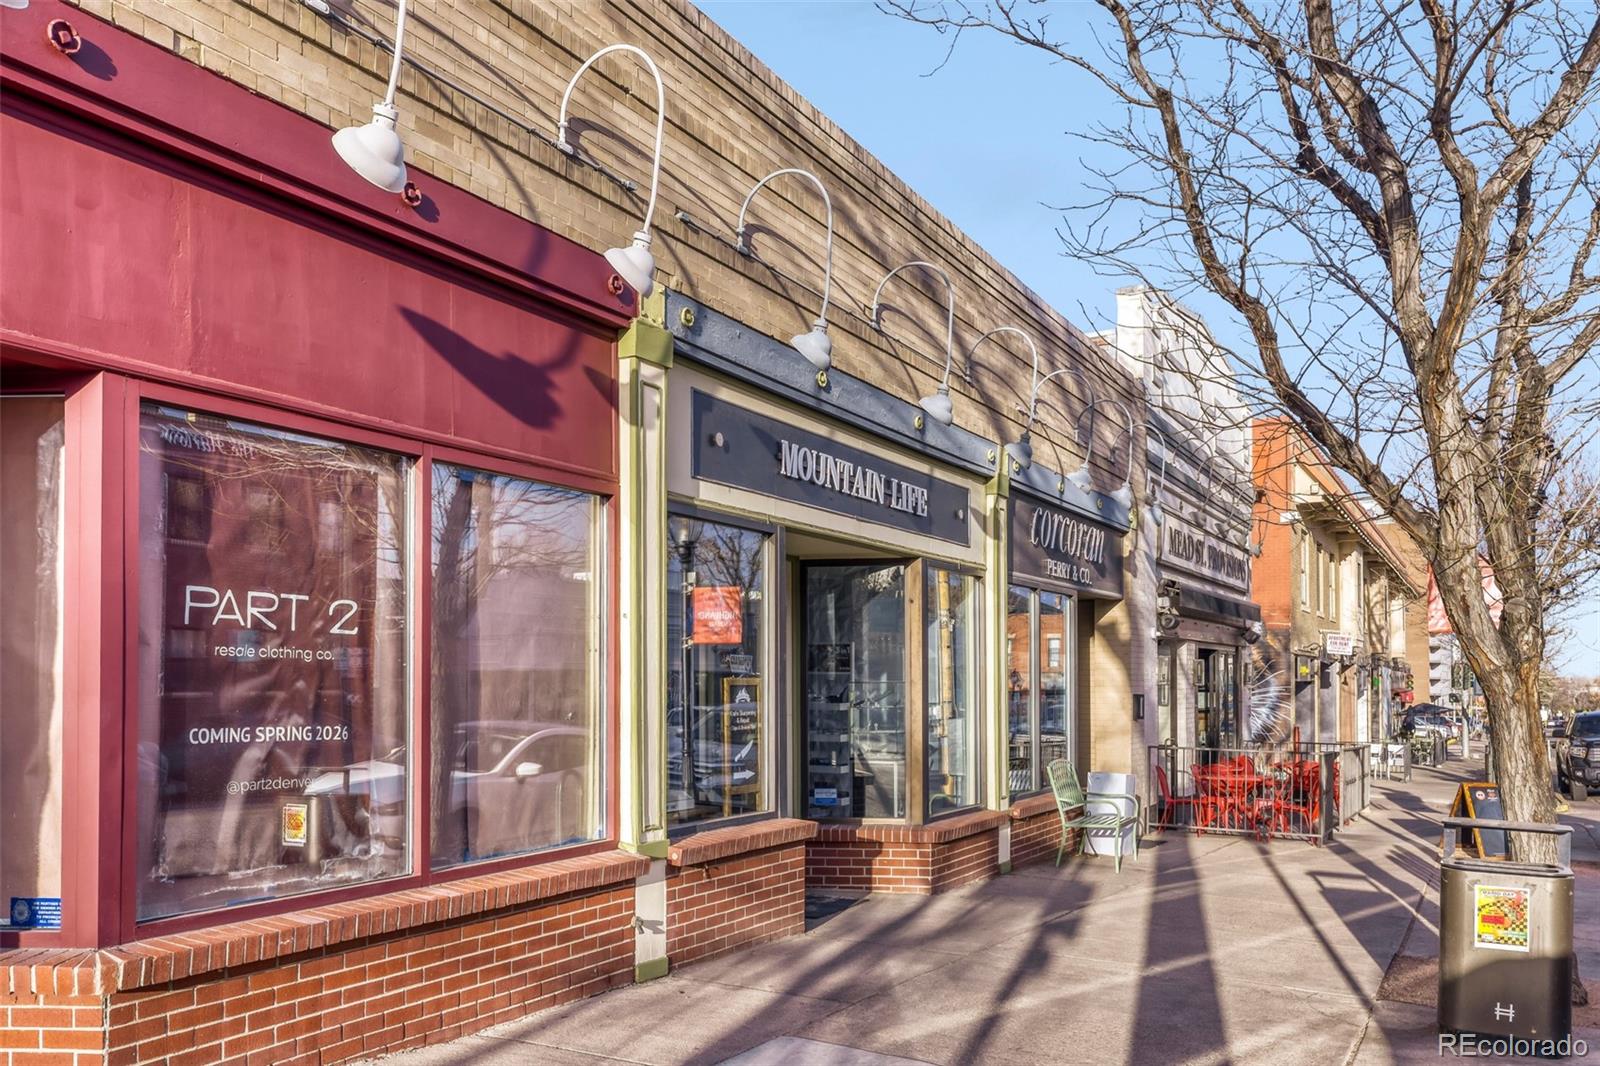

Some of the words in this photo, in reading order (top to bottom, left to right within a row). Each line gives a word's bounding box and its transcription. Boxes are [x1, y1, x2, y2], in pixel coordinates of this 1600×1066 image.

[780, 439, 886, 505] MOUNTAIN
[889, 478, 928, 518] LIFE
[1168, 526, 1195, 562] MEAD
[1046, 558, 1071, 581] PERRY
[1072, 567, 1079, 581] &
[1079, 568, 1093, 585] CO.
[184, 585, 309, 631] PART
[328, 599, 359, 635] 2
[214, 644, 255, 657] resale
[258, 645, 313, 662] clothing
[316, 649, 335, 661] co.
[189, 727, 251, 744] COMING
[255, 725, 312, 742] SPRING
[315, 725, 349, 741] 2026
